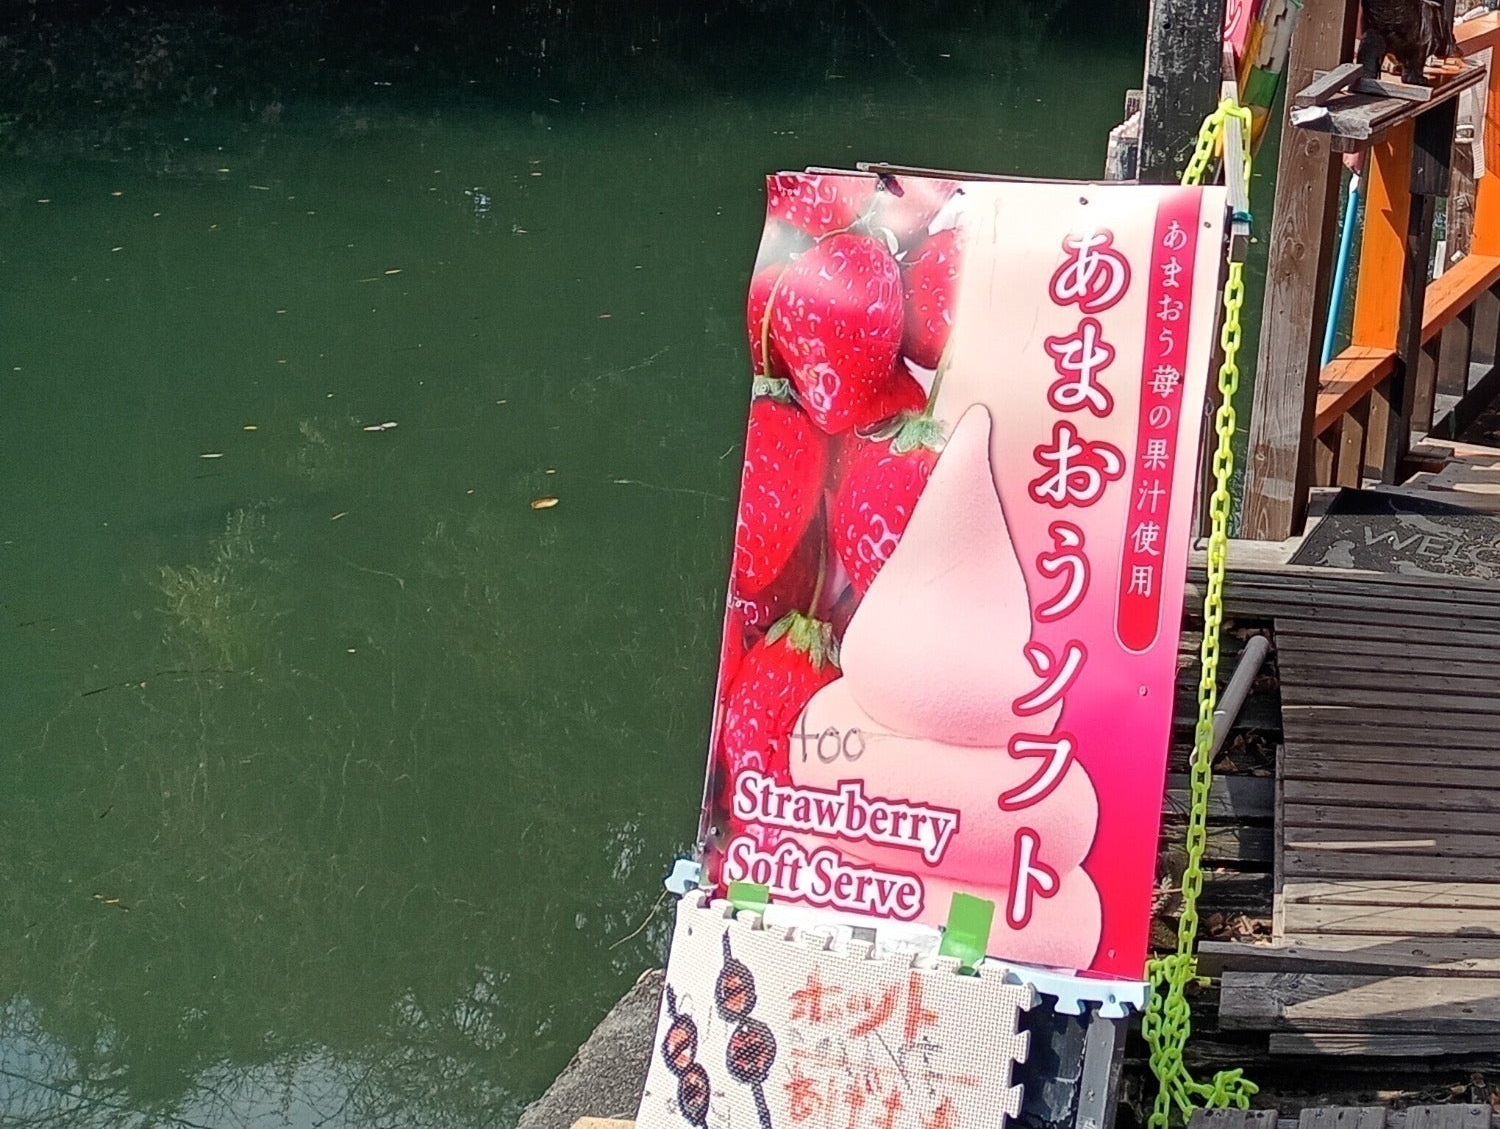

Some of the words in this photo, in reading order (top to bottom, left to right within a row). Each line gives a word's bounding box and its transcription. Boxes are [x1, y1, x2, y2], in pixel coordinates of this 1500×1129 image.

[1126, 219, 1188, 600] あまおう苺の果汁使用
[997, 225, 1130, 929] あまおうソフト
[736, 774, 954, 858] Strawberry
[728, 841, 803, 892] Soft
[810, 856, 916, 911] Serve
[788, 964, 939, 1049] ホット
